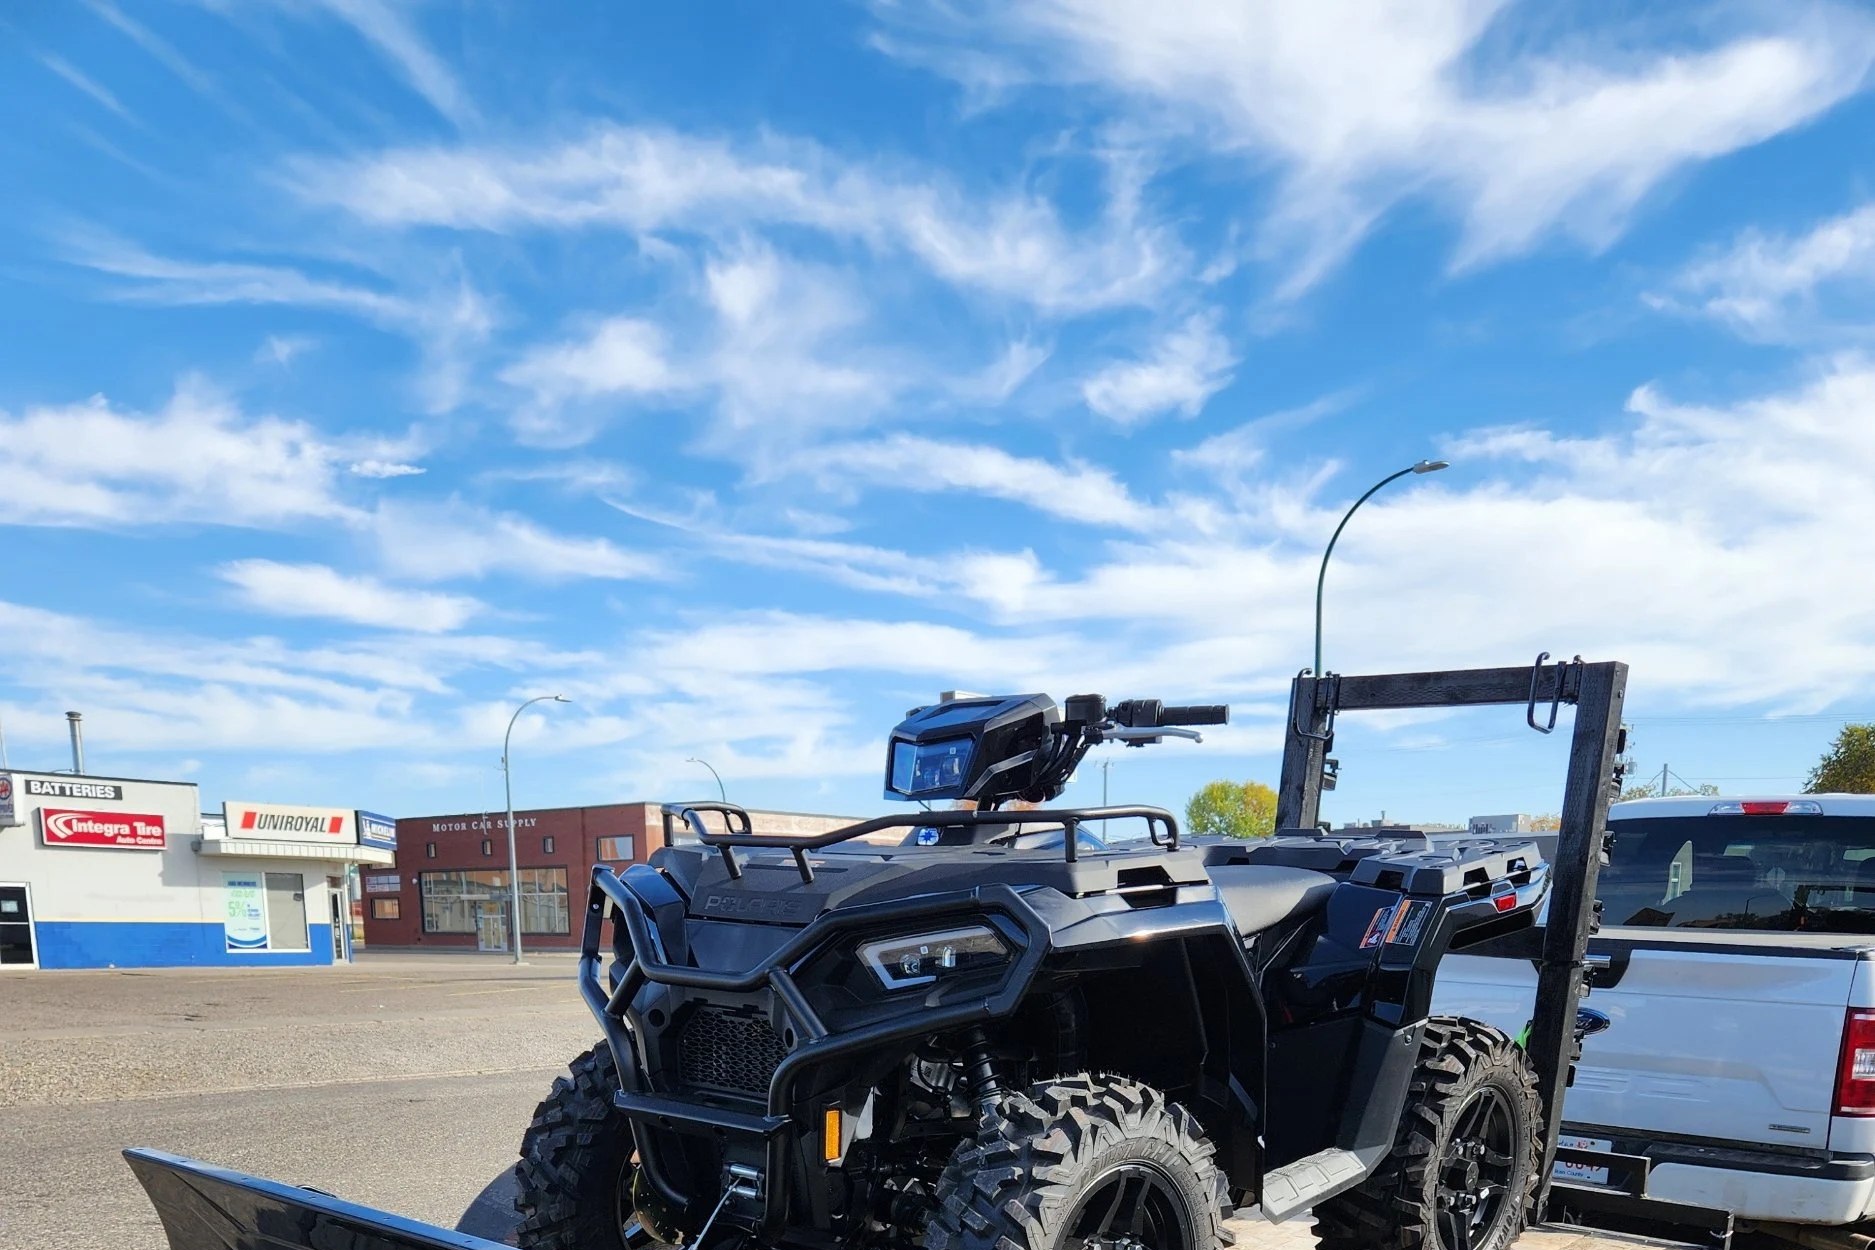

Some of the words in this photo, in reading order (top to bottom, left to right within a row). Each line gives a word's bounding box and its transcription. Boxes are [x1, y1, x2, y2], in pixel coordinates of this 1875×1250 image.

[30, 781, 115, 798] BATTERIES
[72, 819, 130, 836] Integra
[133, 822, 162, 836] Tire
[257, 814, 326, 833] UNIROYAL
[432, 823, 467, 832] MOTOR
[471, 820, 492, 831] CAR
[704, 895, 802, 917] POLARIS
